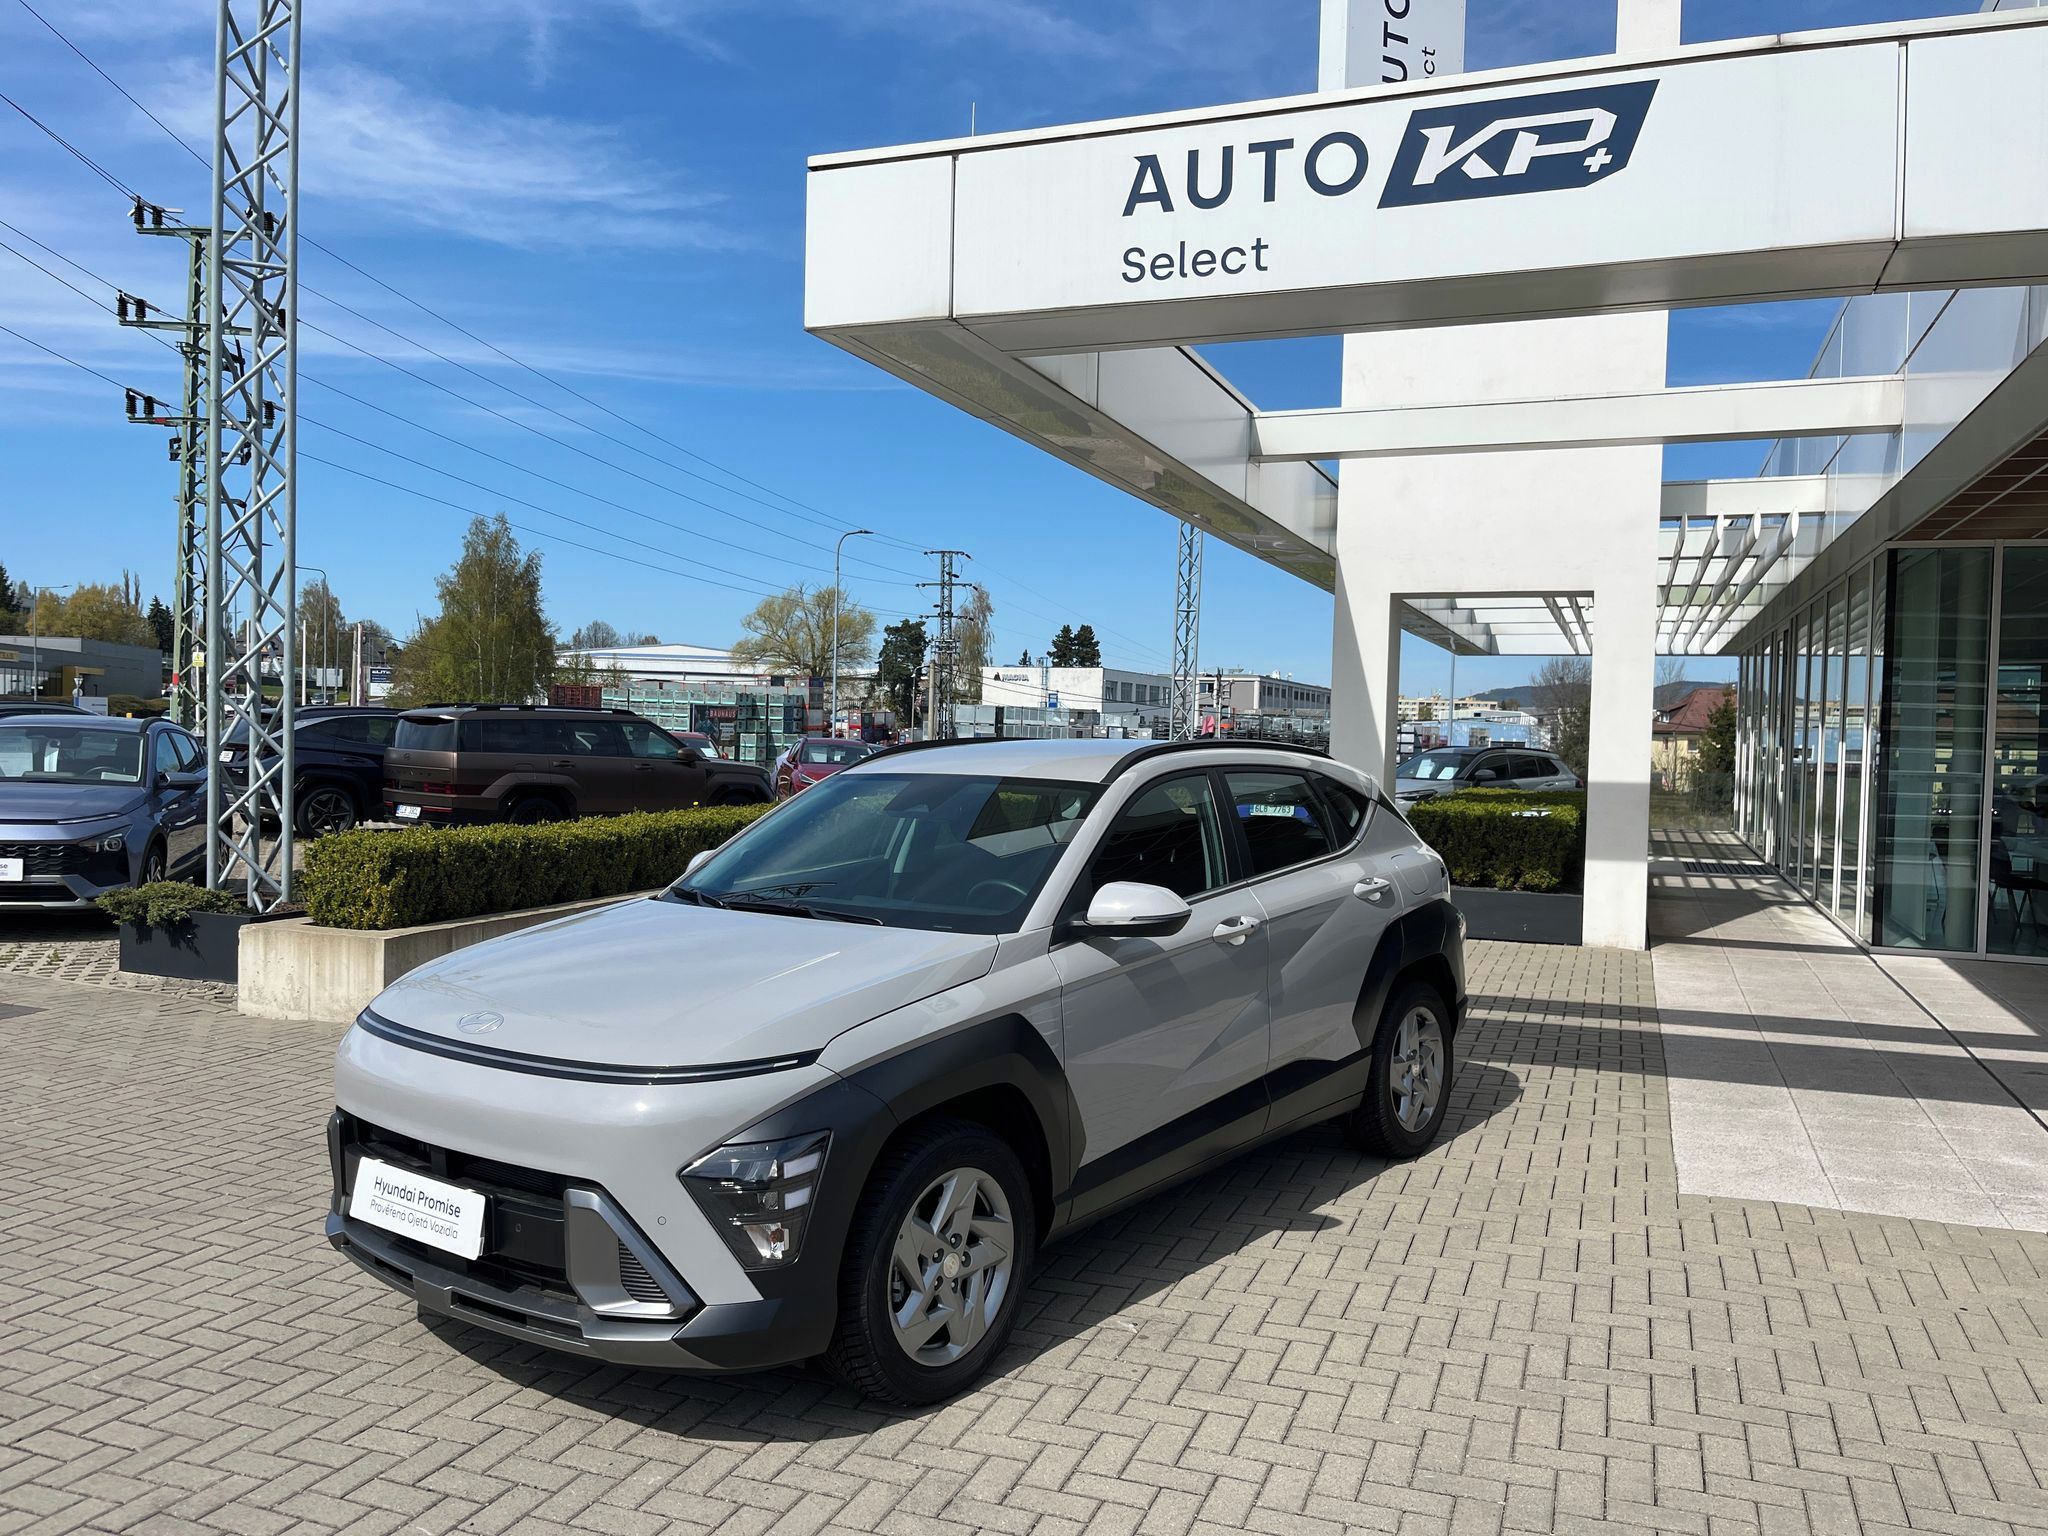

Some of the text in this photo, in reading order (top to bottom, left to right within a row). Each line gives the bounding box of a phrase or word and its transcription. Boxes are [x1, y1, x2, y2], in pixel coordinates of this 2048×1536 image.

[1122, 130, 1369, 217] AUTO
[1121, 236, 1269, 283] Select
[370, 1199, 458, 1239] Prověřená Ojetá Vozidla
[375, 1176, 461, 1218] Hyundai Promise
